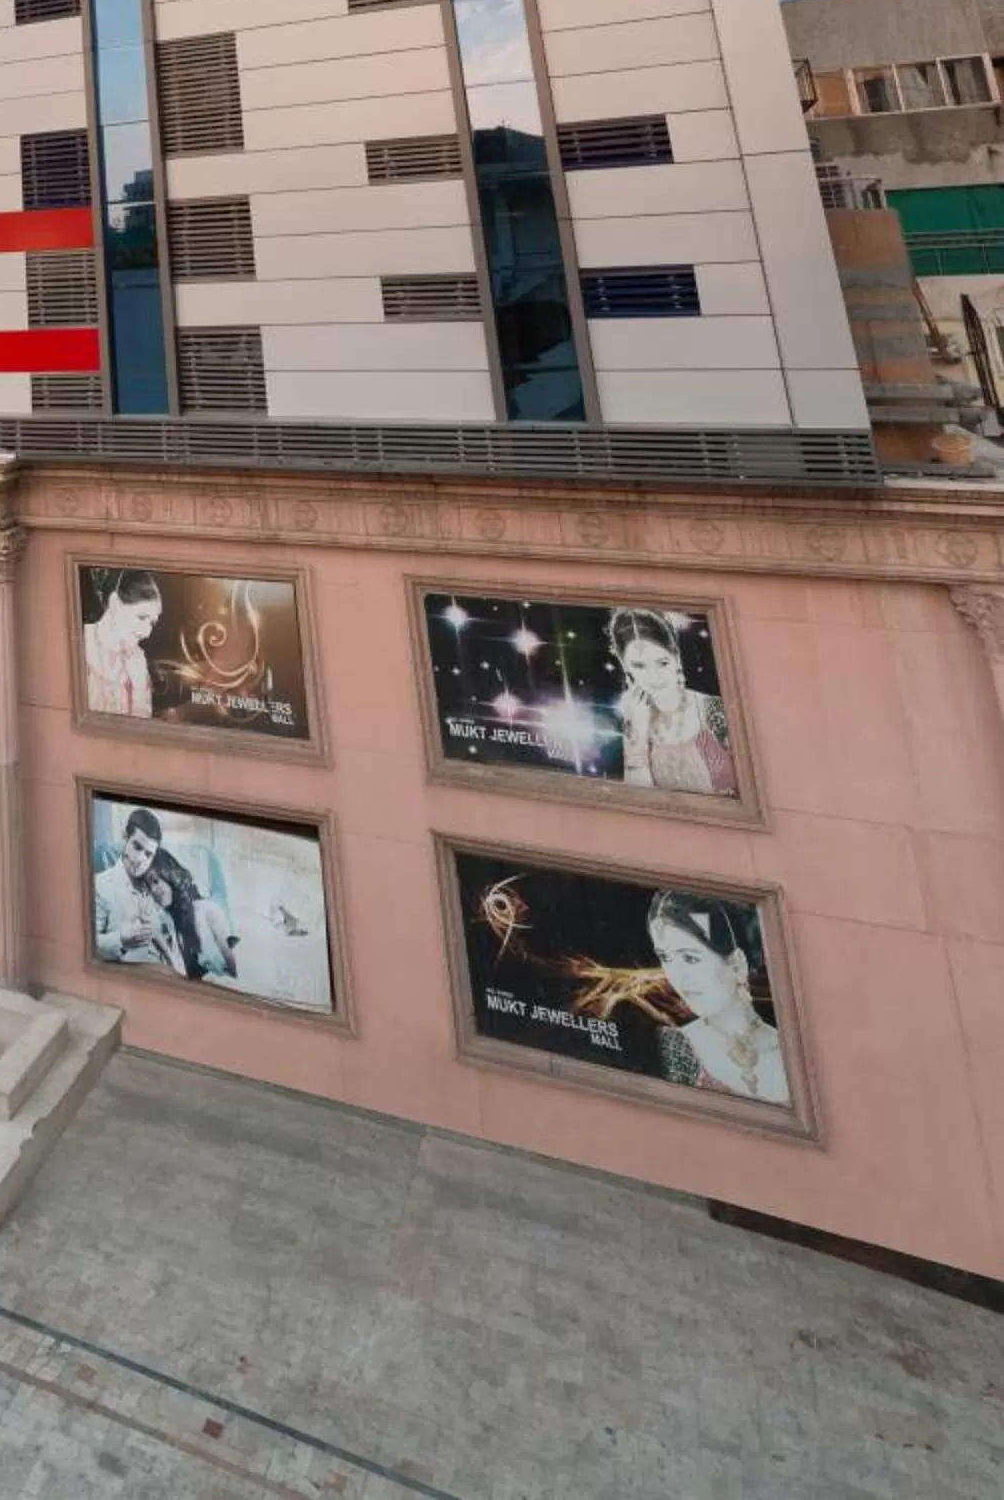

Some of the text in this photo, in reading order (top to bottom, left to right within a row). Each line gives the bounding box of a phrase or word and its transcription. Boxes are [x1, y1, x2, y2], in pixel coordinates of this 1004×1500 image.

[449, 723, 486, 739] MUKT
[486, 994, 619, 1037] MUKT JEWELLERS
[590, 1032, 623, 1051] MALL
